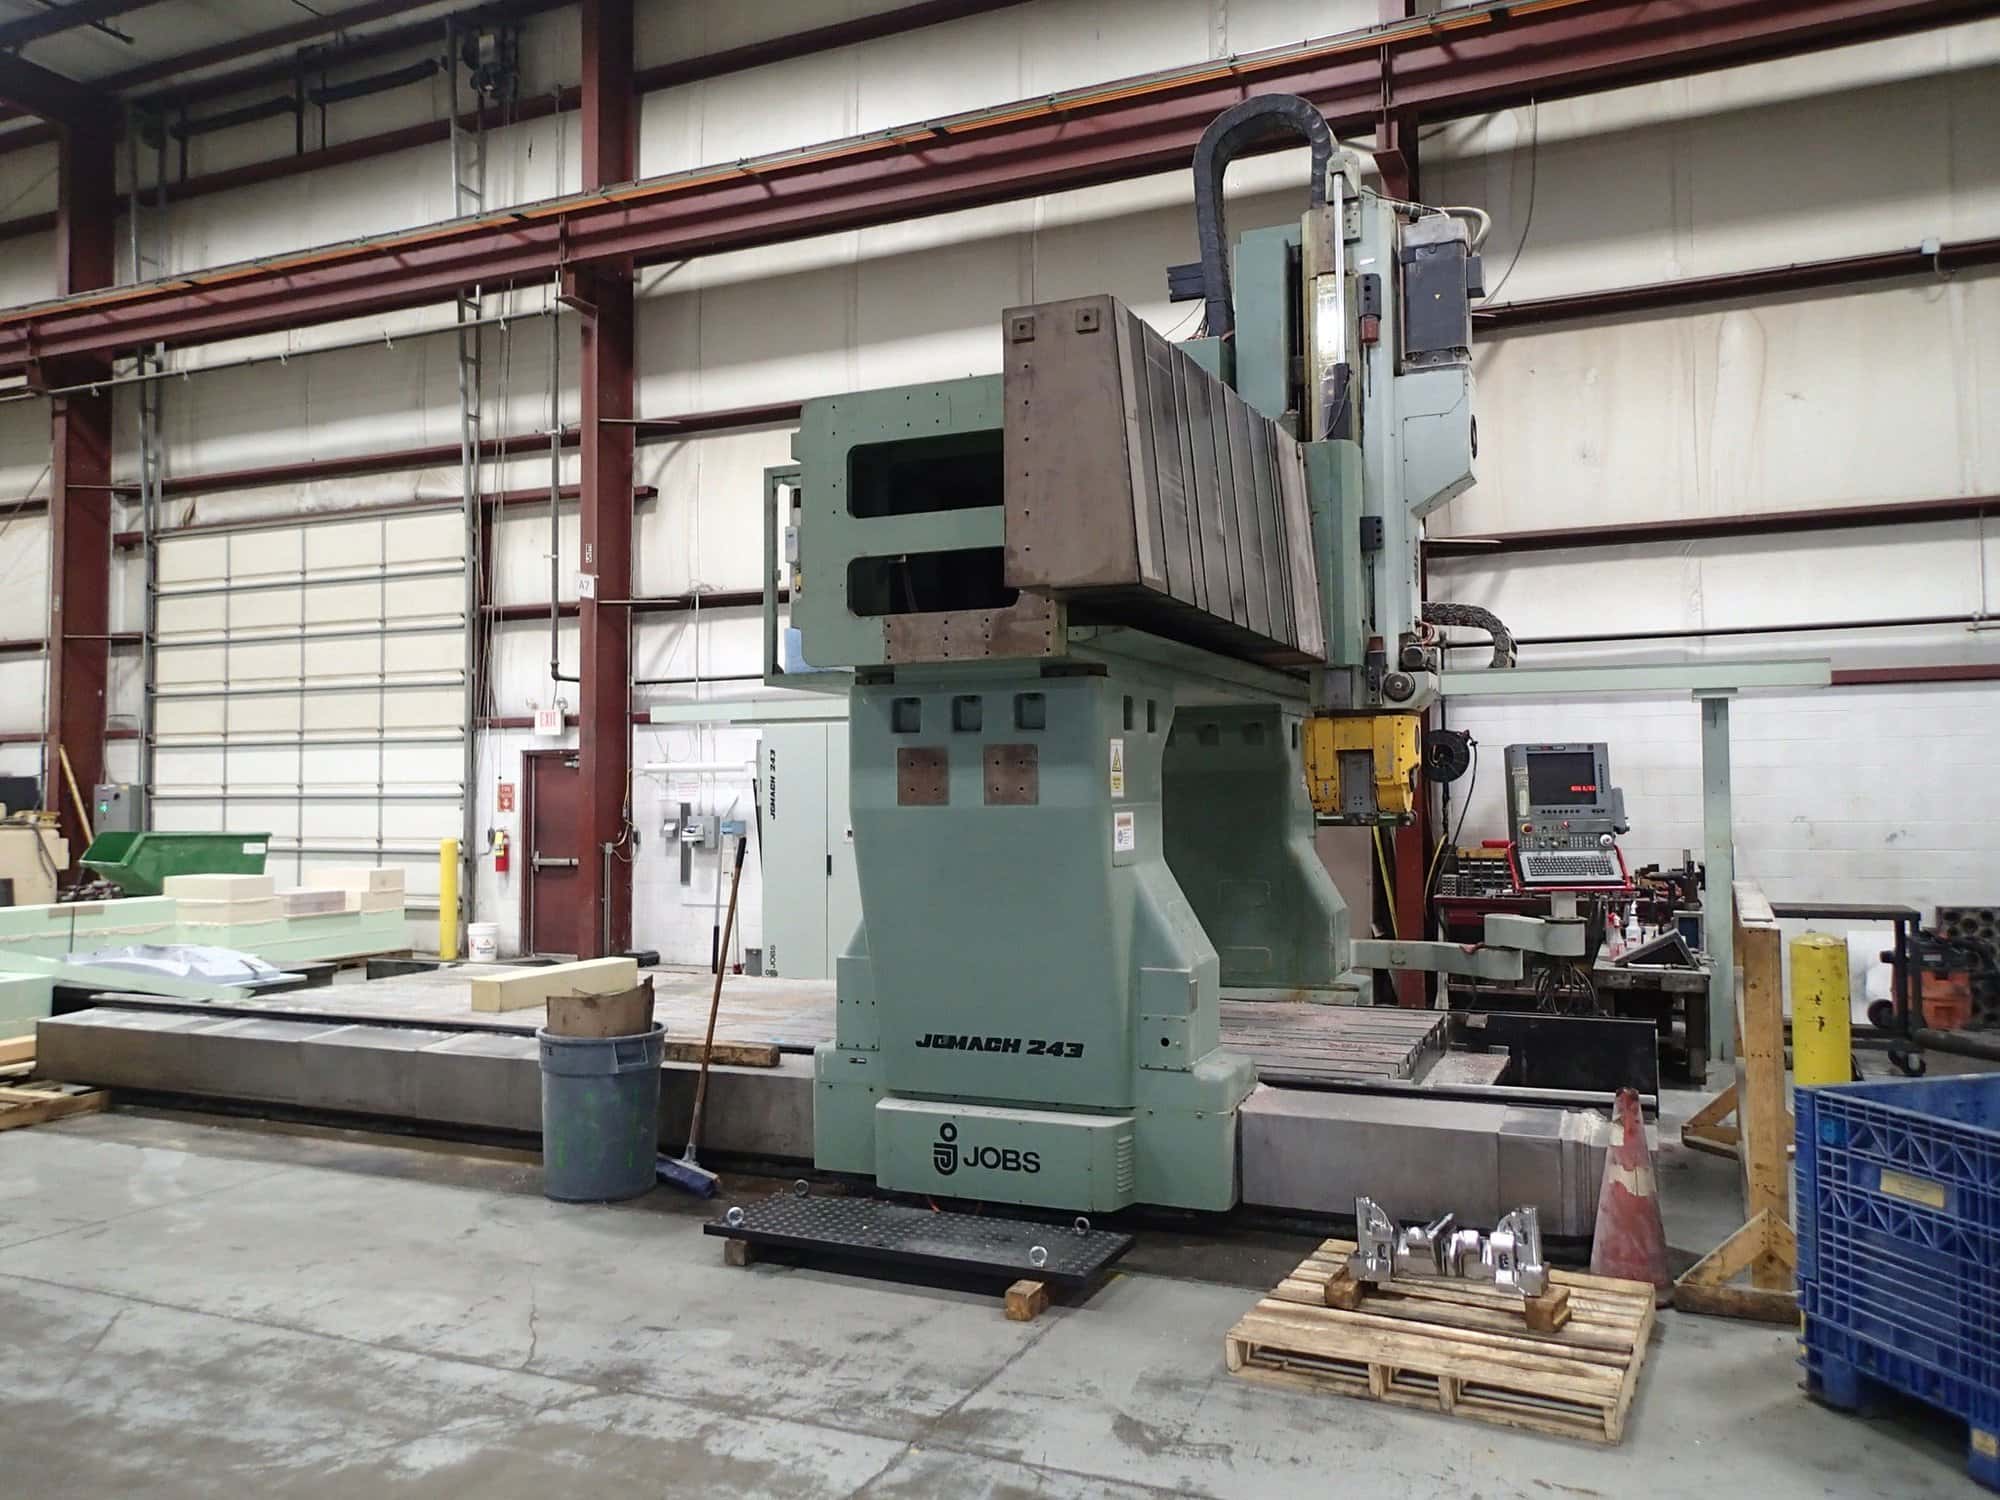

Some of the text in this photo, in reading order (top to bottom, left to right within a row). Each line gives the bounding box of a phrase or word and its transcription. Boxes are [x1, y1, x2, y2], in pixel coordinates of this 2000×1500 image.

[540, 711, 556, 728] EXIT
[915, 1033, 1084, 1058] JOMACH 243
[963, 1146, 1041, 1173] JOBS
